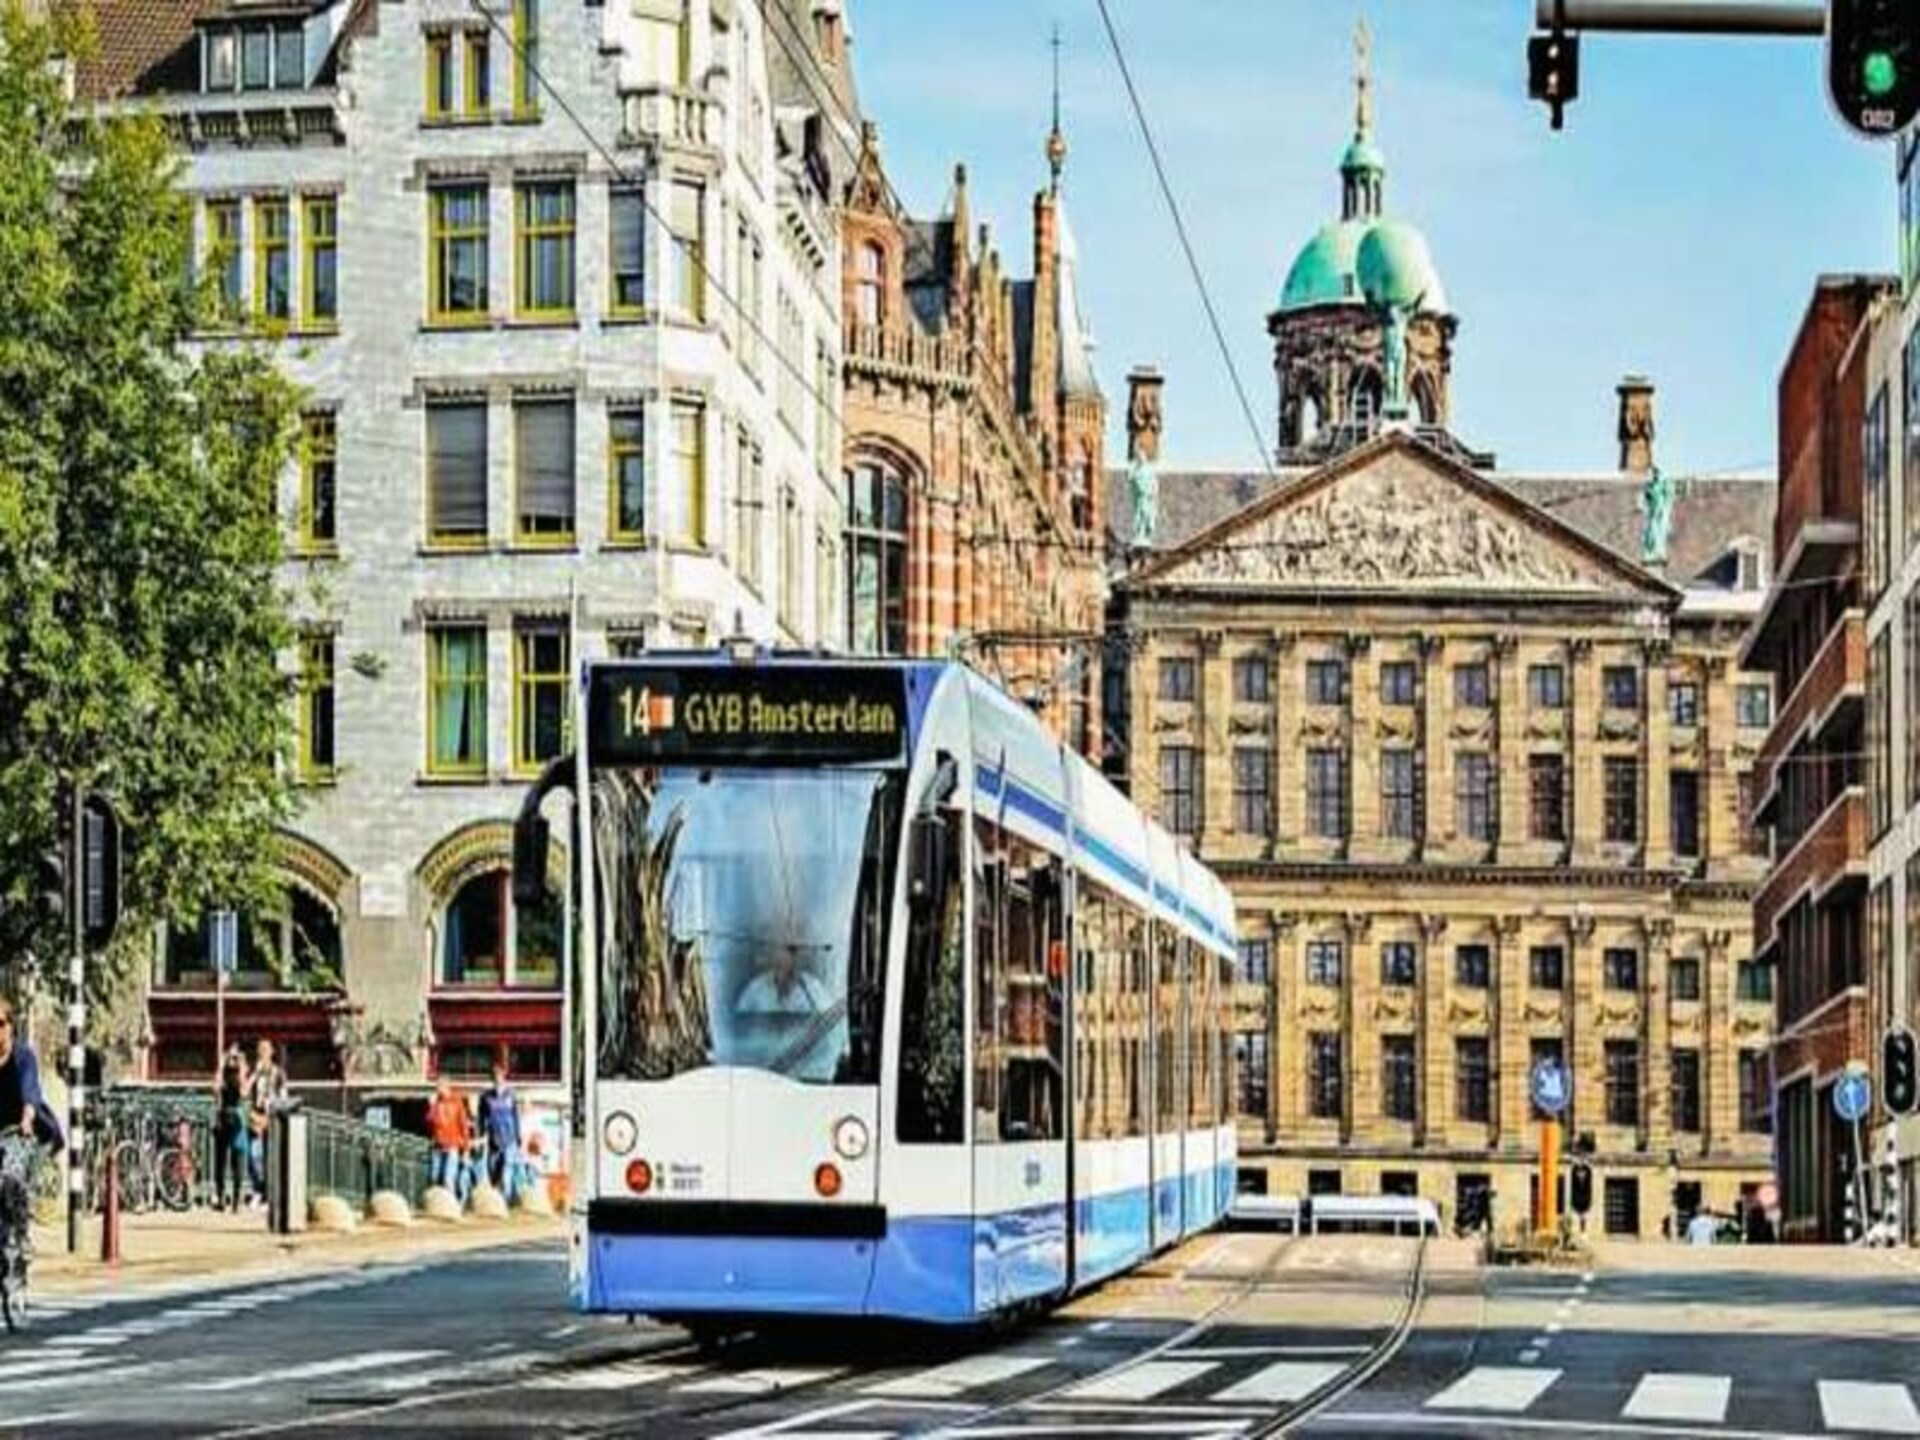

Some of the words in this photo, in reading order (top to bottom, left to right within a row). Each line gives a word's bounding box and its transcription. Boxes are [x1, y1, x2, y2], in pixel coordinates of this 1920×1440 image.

[619, 686, 651, 736] 14
[684, 694, 742, 733] GVB
[749, 694, 896, 733] Amsterdam
